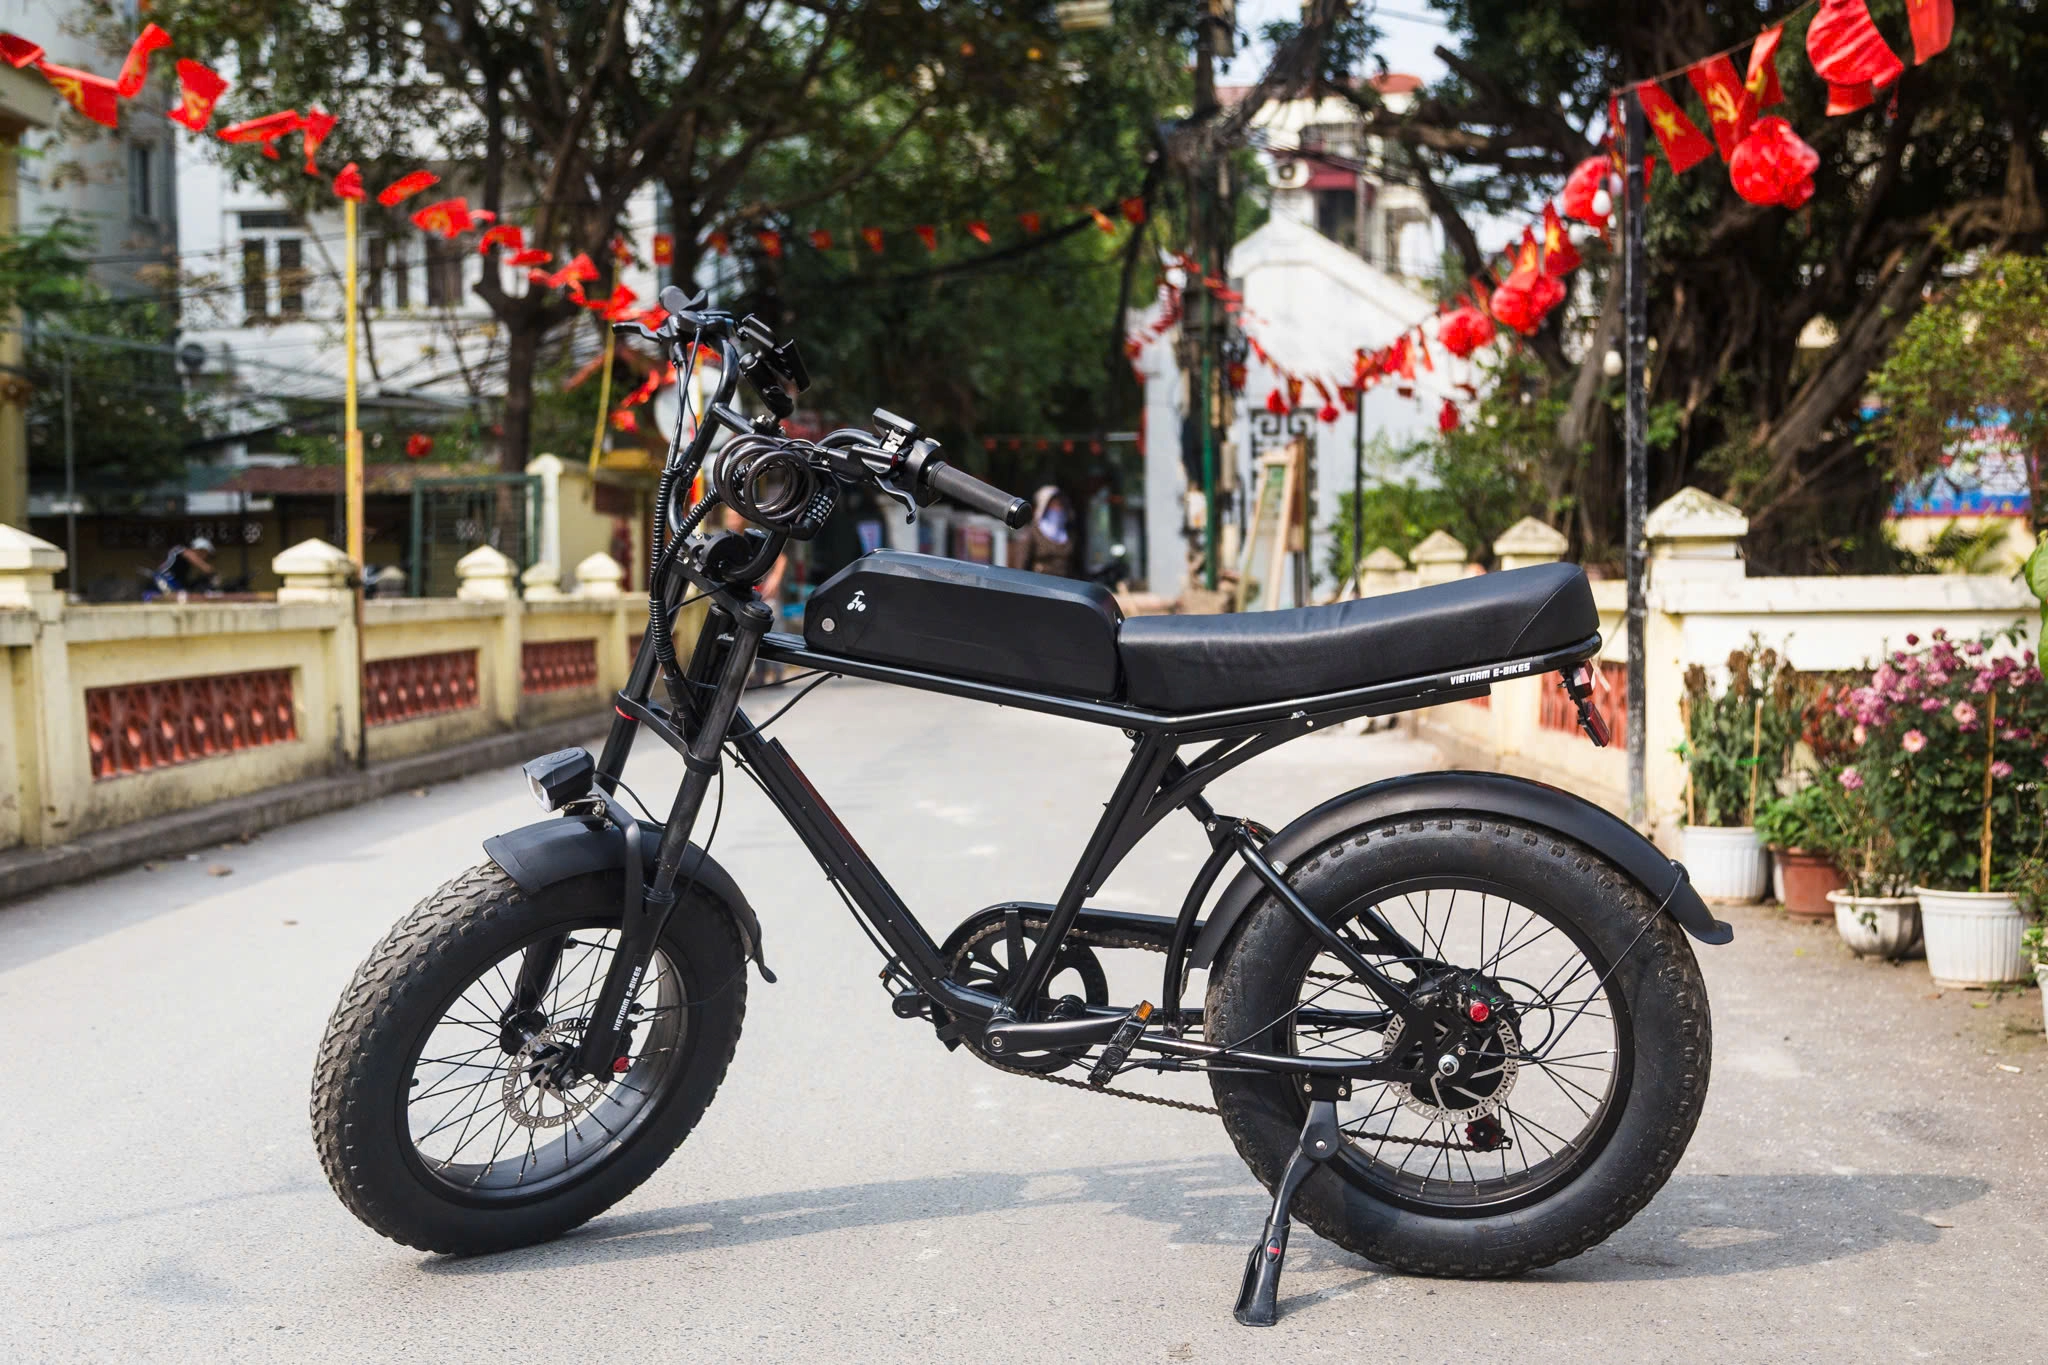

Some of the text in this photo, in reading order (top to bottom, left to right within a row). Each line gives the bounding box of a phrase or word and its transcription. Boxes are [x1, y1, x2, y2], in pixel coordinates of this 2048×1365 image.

[1450, 662, 1531, 685] VIETNAM E-BIKES
[613, 966, 642, 1031] VIETNAM E-BIKES
